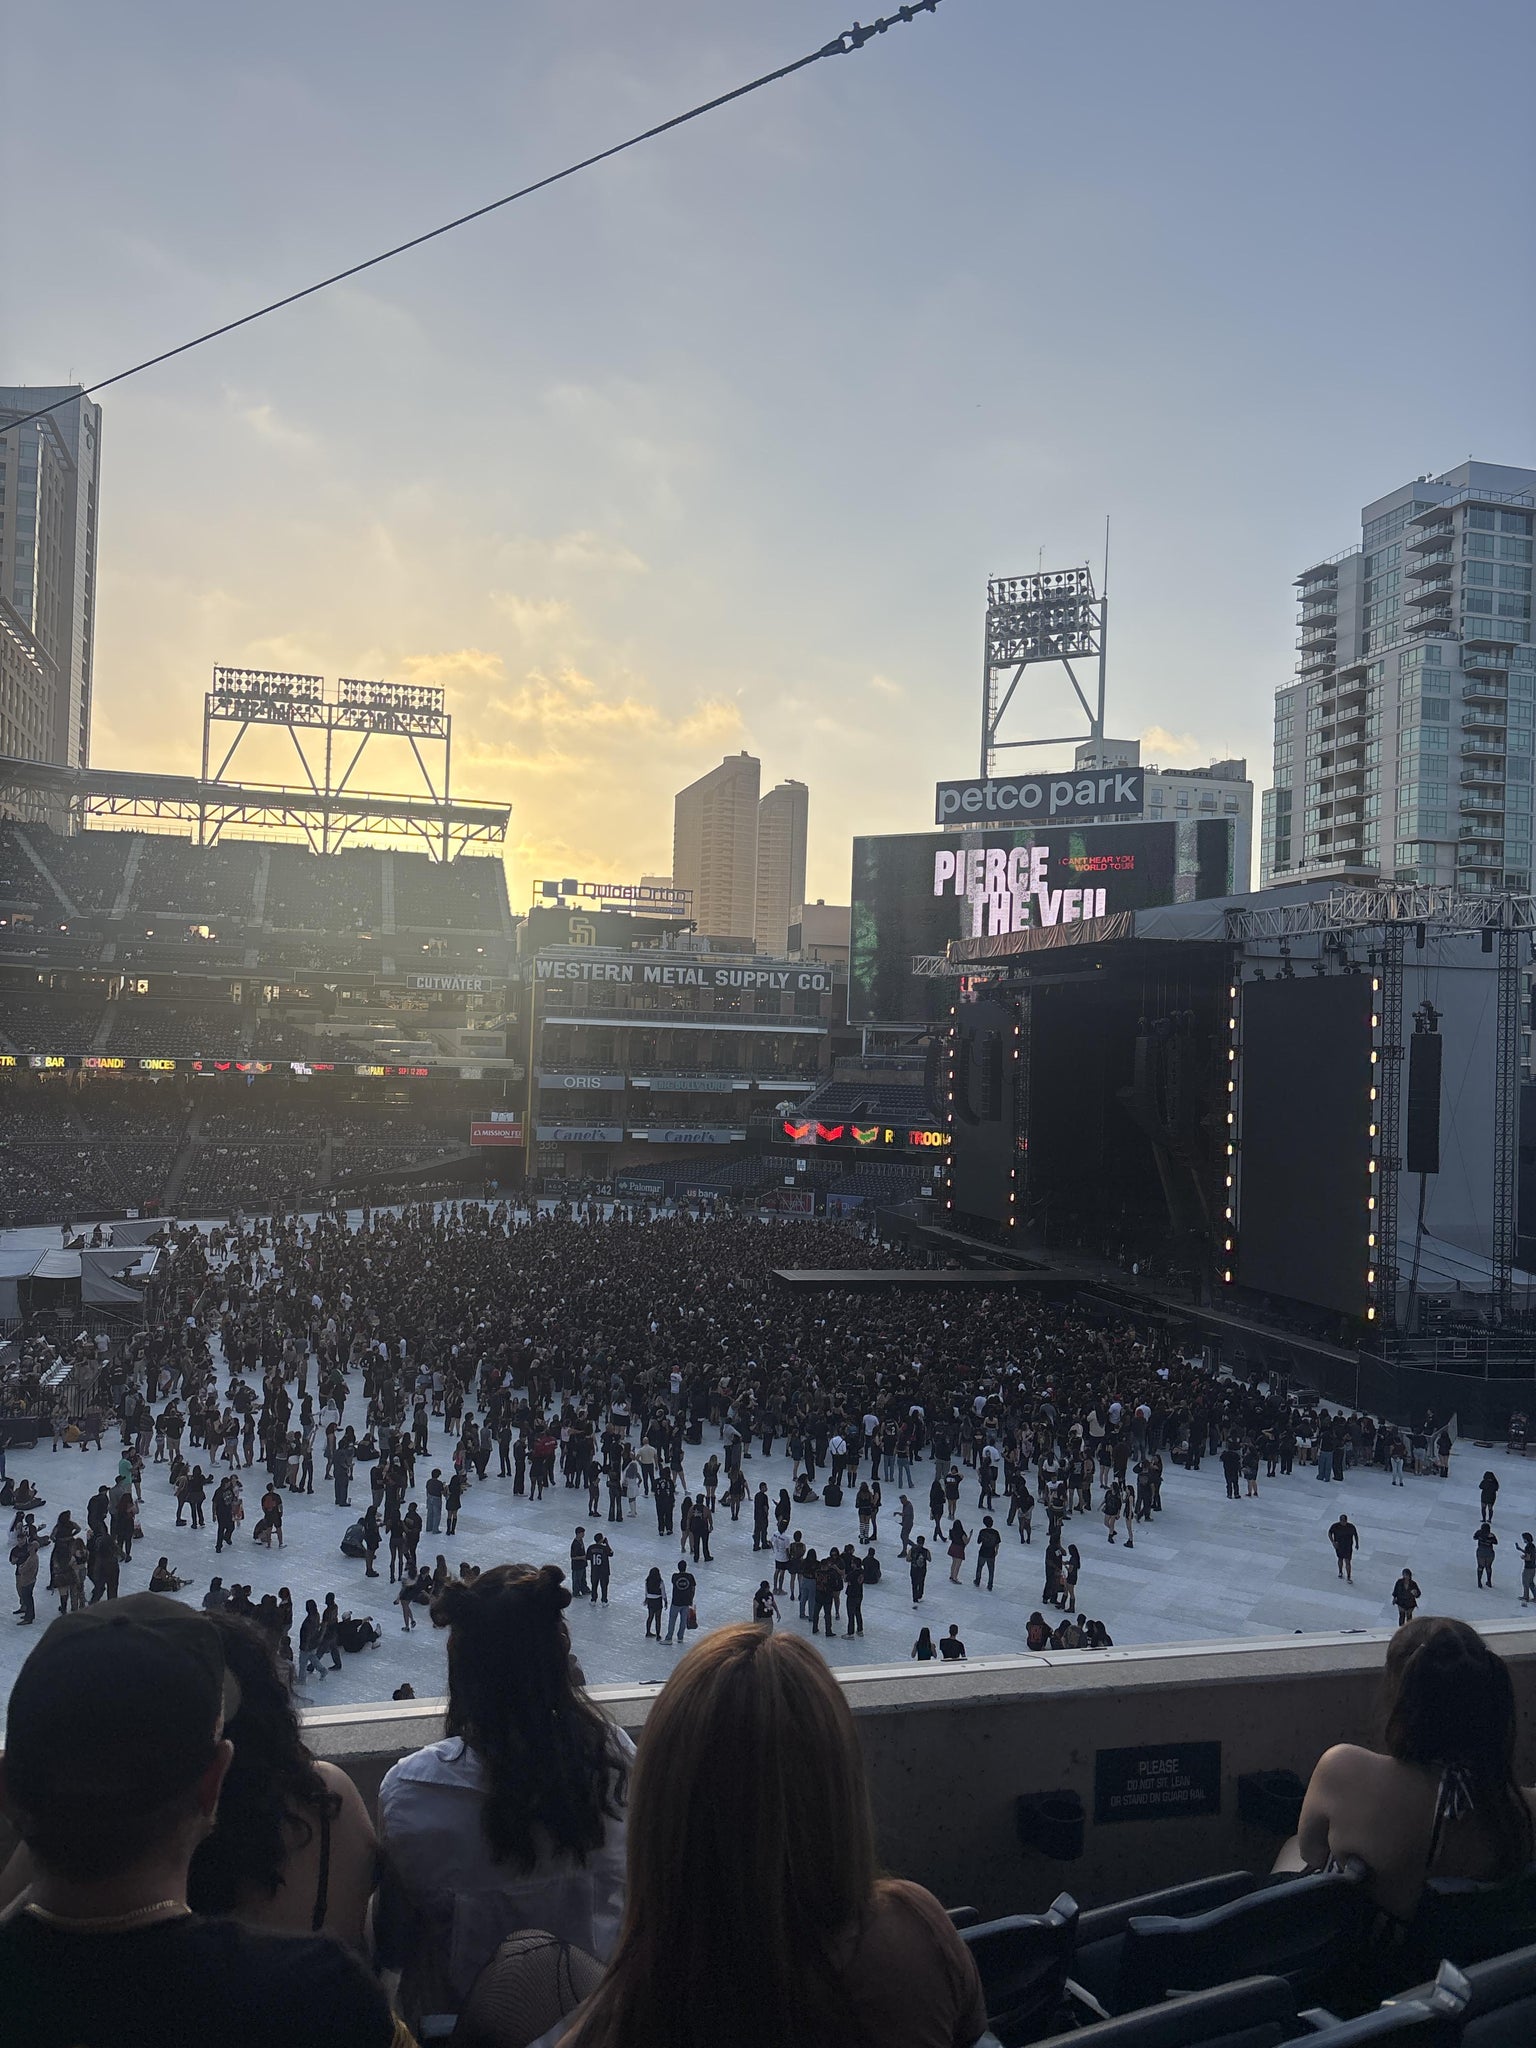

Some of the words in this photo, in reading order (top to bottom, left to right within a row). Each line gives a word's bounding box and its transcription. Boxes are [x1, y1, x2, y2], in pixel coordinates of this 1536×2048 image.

[938, 780, 1043, 821] petco
[1049, 774, 1138, 815] park
[1089, 856, 1112, 864] HEAR
[1115, 855, 1134, 863] YOU
[934, 847, 1049, 896] PIERCE
[968, 890, 1030, 937] THE
[536, 960, 633, 983] WESTERN
[643, 967, 709, 987] METAL
[715, 970, 789, 990] SUPPLY
[798, 973, 830, 991] CO.
[416, 977, 482, 991] CUTWATER
[45, 1057, 65, 1068] BAR
[563, 1076, 601, 1088] ORIS
[482, 1129, 511, 1137] MISSION
[595, 1184, 612, 1195] 342
[629, 1181, 662, 1195] Palomar
[687, 1189, 697, 1197] us
[593, 1554, 602, 1566] 16
[1139, 1758, 1180, 1775] PLEASE
[1127, 1779, 1138, 1791] DO
[1139, 1778, 1155, 1790] NOT
[1171, 1775, 1191, 1787] LEAN
[1110, 1795, 1122, 1807] OR
[1122, 1793, 1148, 1806] STAND
[1149, 1792, 1161, 1803] ON
[1162, 1790, 1189, 1802] GUARD
[1190, 1788, 1206, 1800] RAIL
